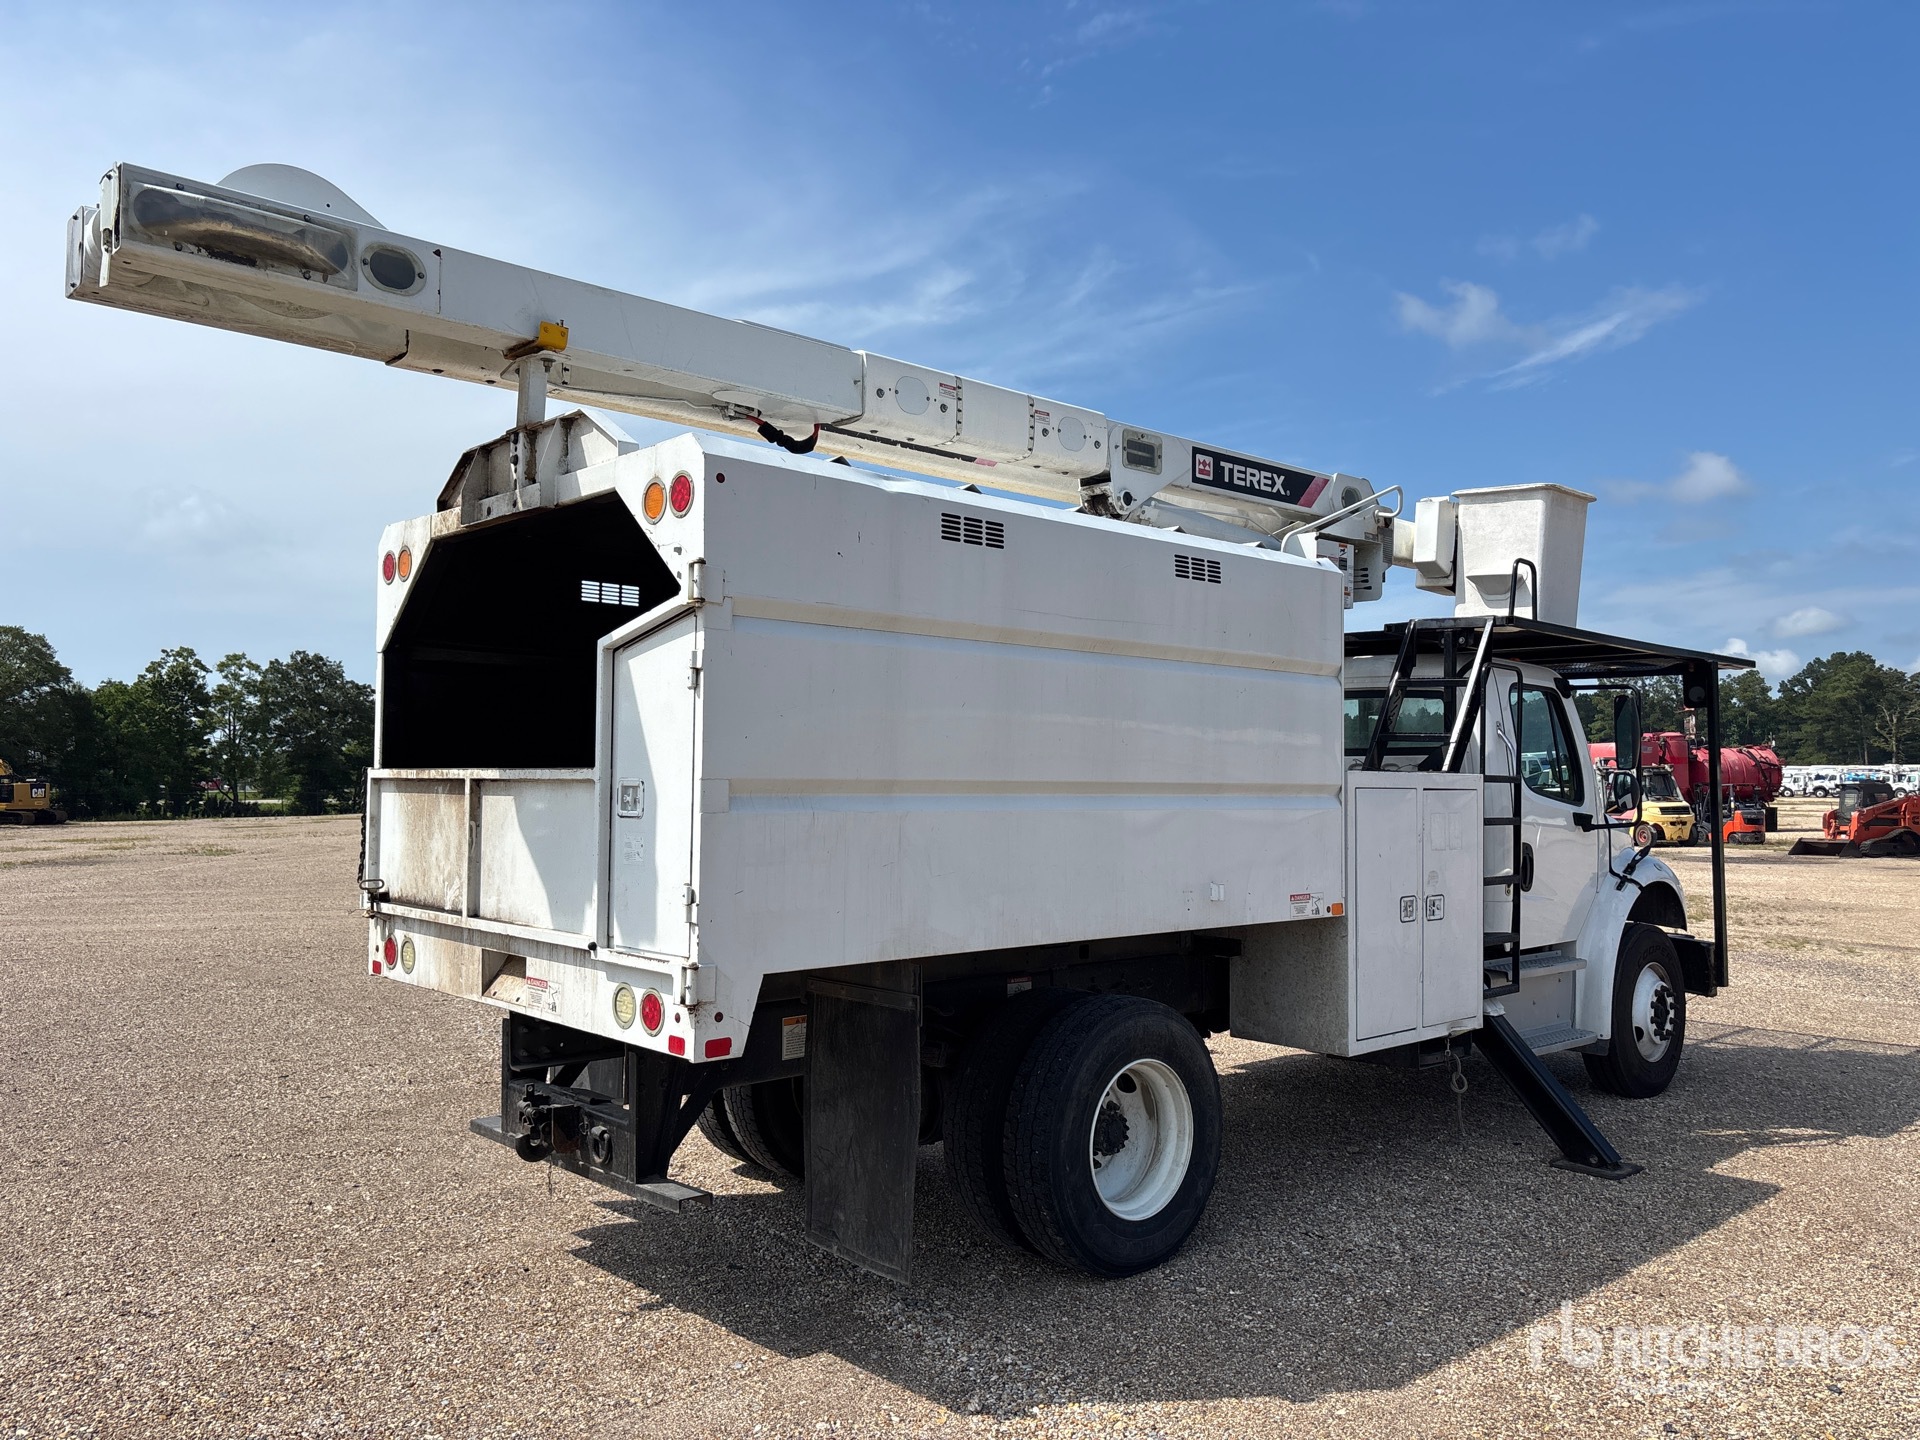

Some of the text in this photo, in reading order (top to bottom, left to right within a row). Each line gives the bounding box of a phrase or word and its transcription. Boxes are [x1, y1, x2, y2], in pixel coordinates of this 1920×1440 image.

[1220, 461, 1286, 496] TEREX
[32, 788, 45, 798] CAT
[1294, 893, 1310, 901] DANGER
[530, 978, 547, 988] DANGER
